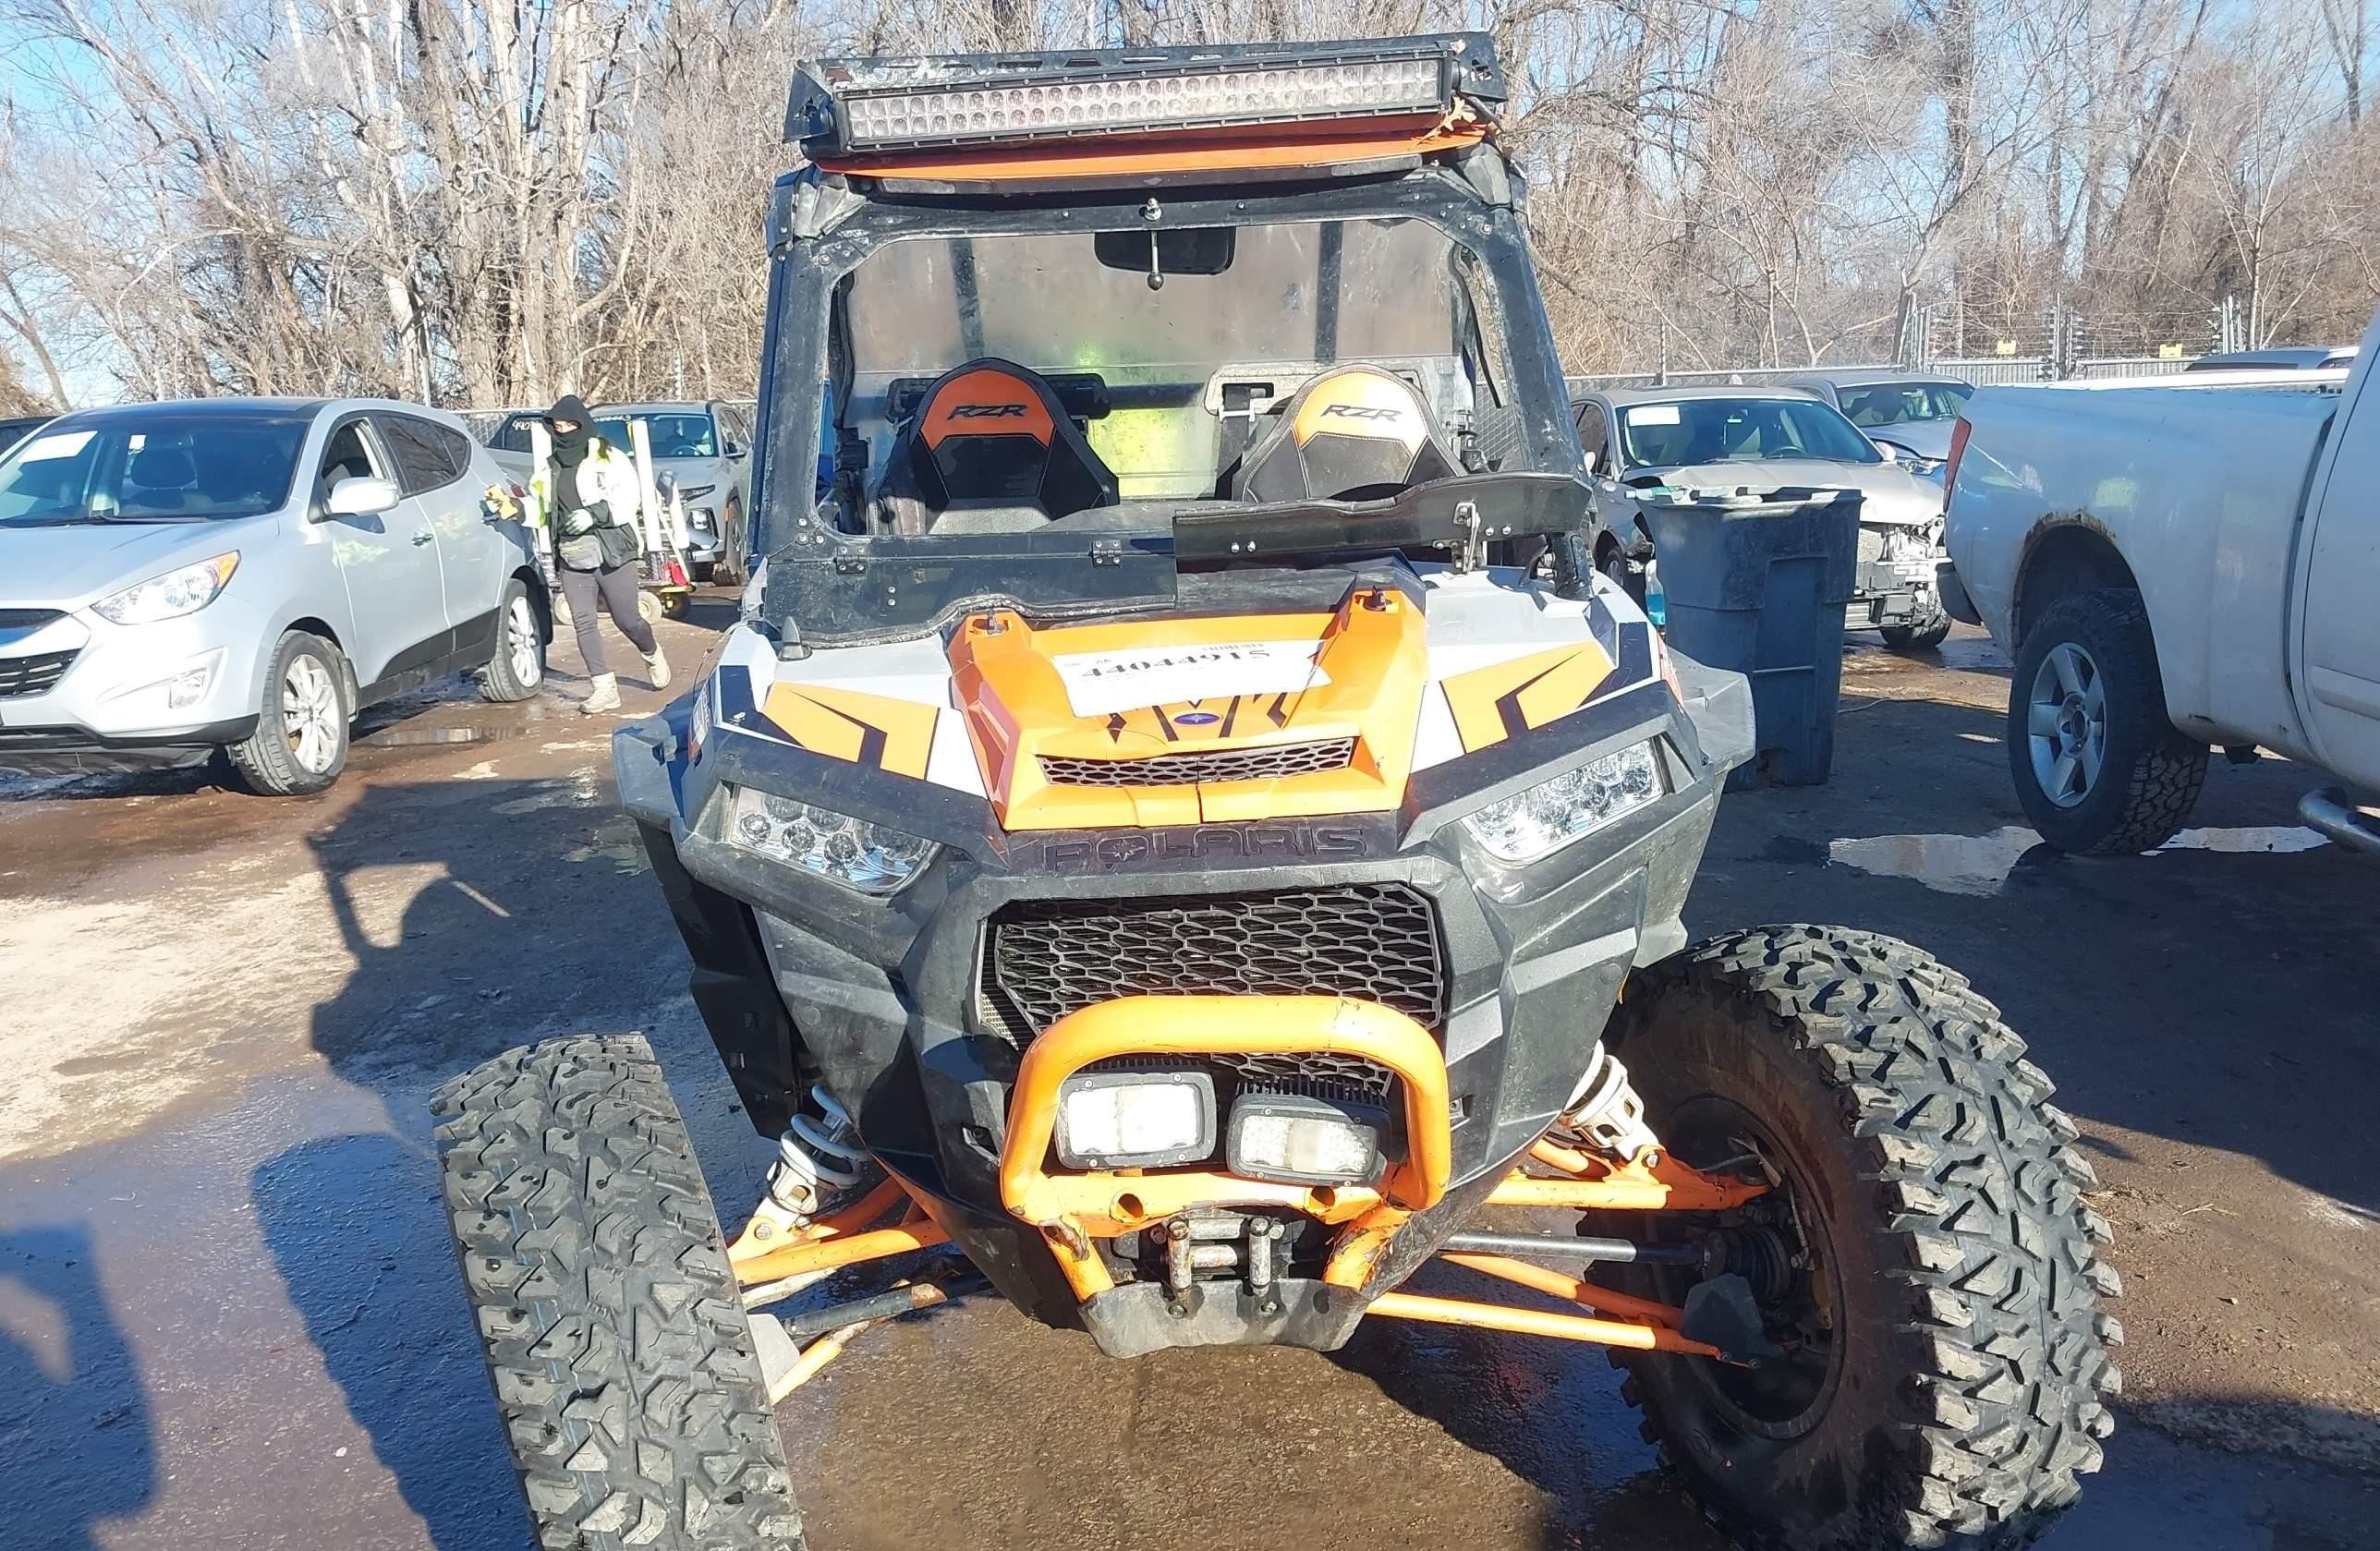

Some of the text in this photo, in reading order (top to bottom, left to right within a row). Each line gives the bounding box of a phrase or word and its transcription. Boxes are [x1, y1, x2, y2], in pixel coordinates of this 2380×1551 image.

[946, 405, 1027, 420] RZR
[1320, 405, 1402, 421] RZR
[1042, 828, 1367, 872] POLARIS
